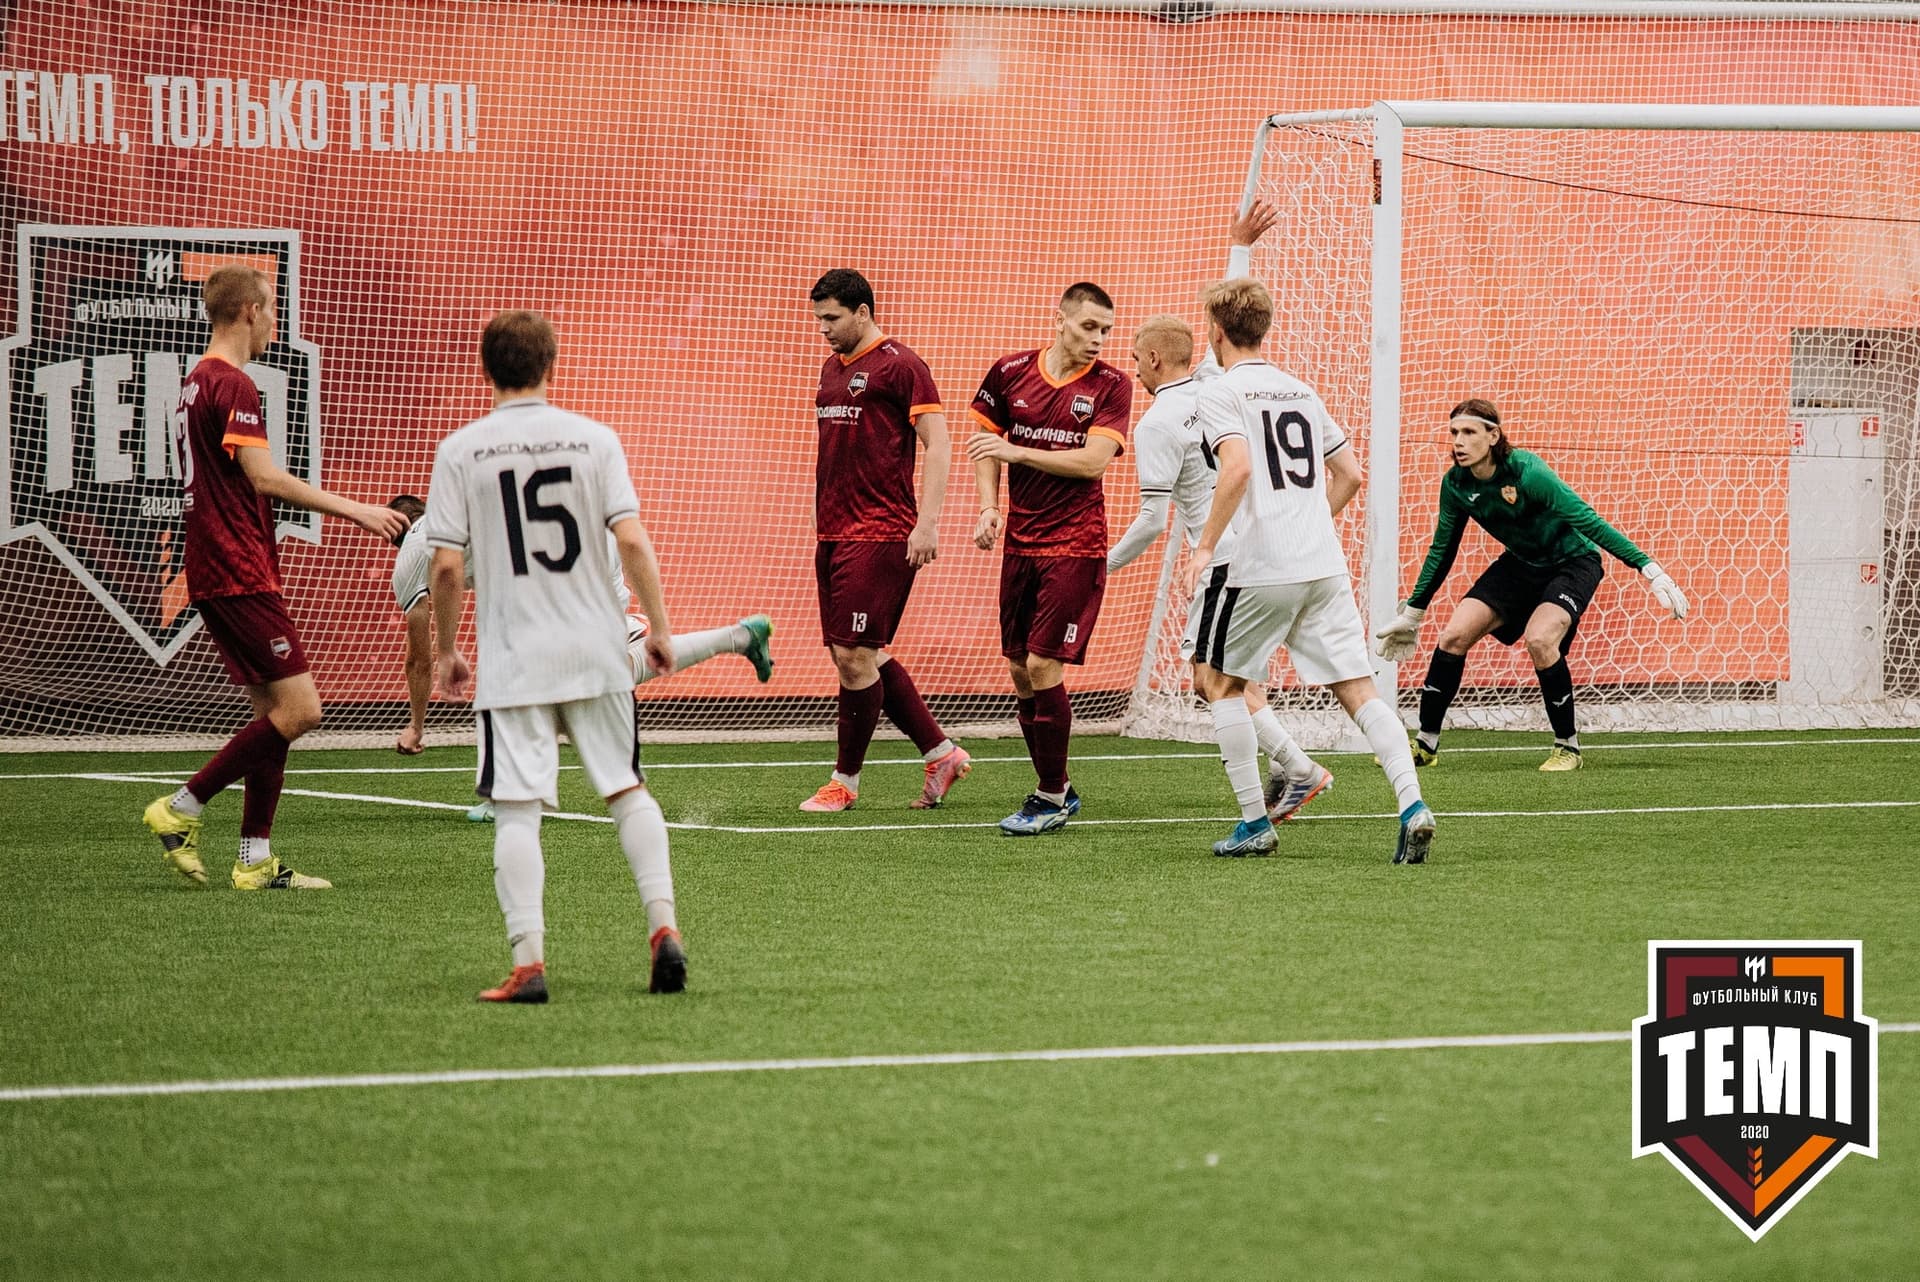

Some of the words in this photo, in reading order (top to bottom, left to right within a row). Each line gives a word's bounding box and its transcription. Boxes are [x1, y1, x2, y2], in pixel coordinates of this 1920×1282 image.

[144, 75, 328, 151] ТОЛЬКО
[343, 81, 478, 153] ТЕМП!
[75, 297, 191, 323] ФУТБОЛЬНЫЙ
[236, 411, 259, 424] ПСБ
[1261, 410, 1316, 491] 19
[142, 497, 180, 518] 2020
[499, 466, 581, 576] 15
[851, 612, 868, 633] 13
[1063, 623, 1078, 643] 19
